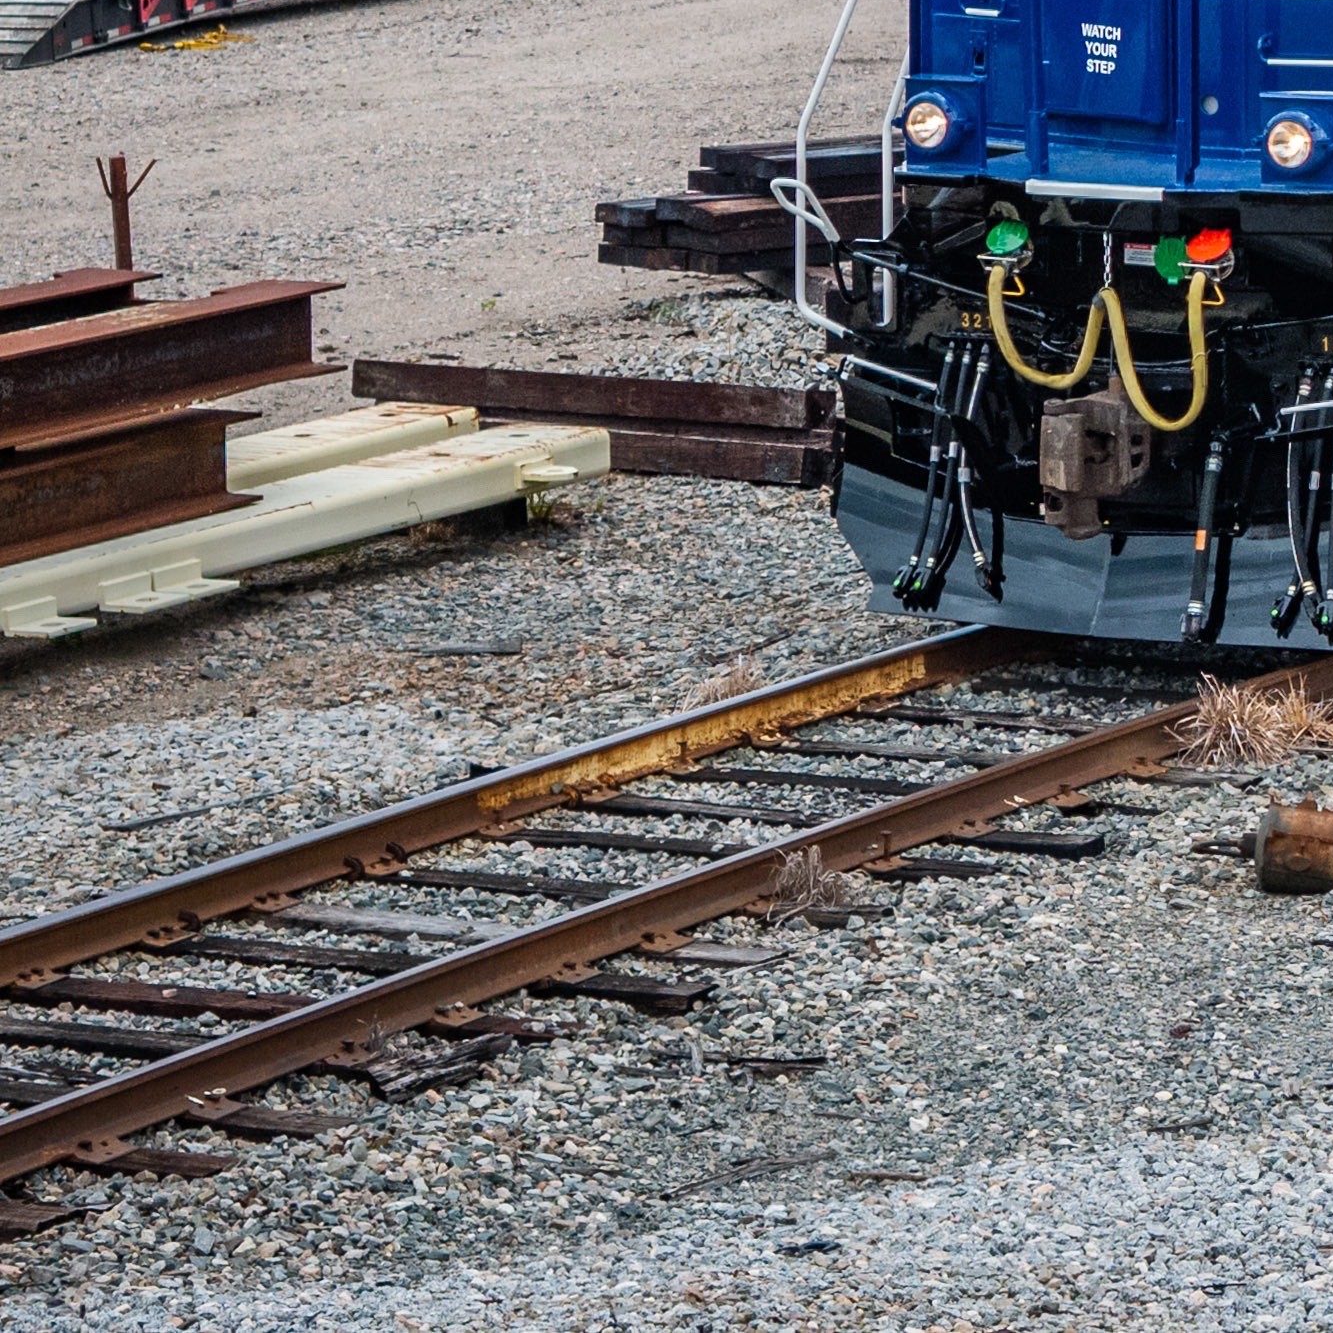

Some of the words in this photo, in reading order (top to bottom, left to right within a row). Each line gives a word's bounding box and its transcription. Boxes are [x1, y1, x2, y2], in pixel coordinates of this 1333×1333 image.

[1082, 22, 1122, 41] WATCH
[1085, 40, 1118, 58] YOUR
[1086, 58, 1116, 75] STEP
